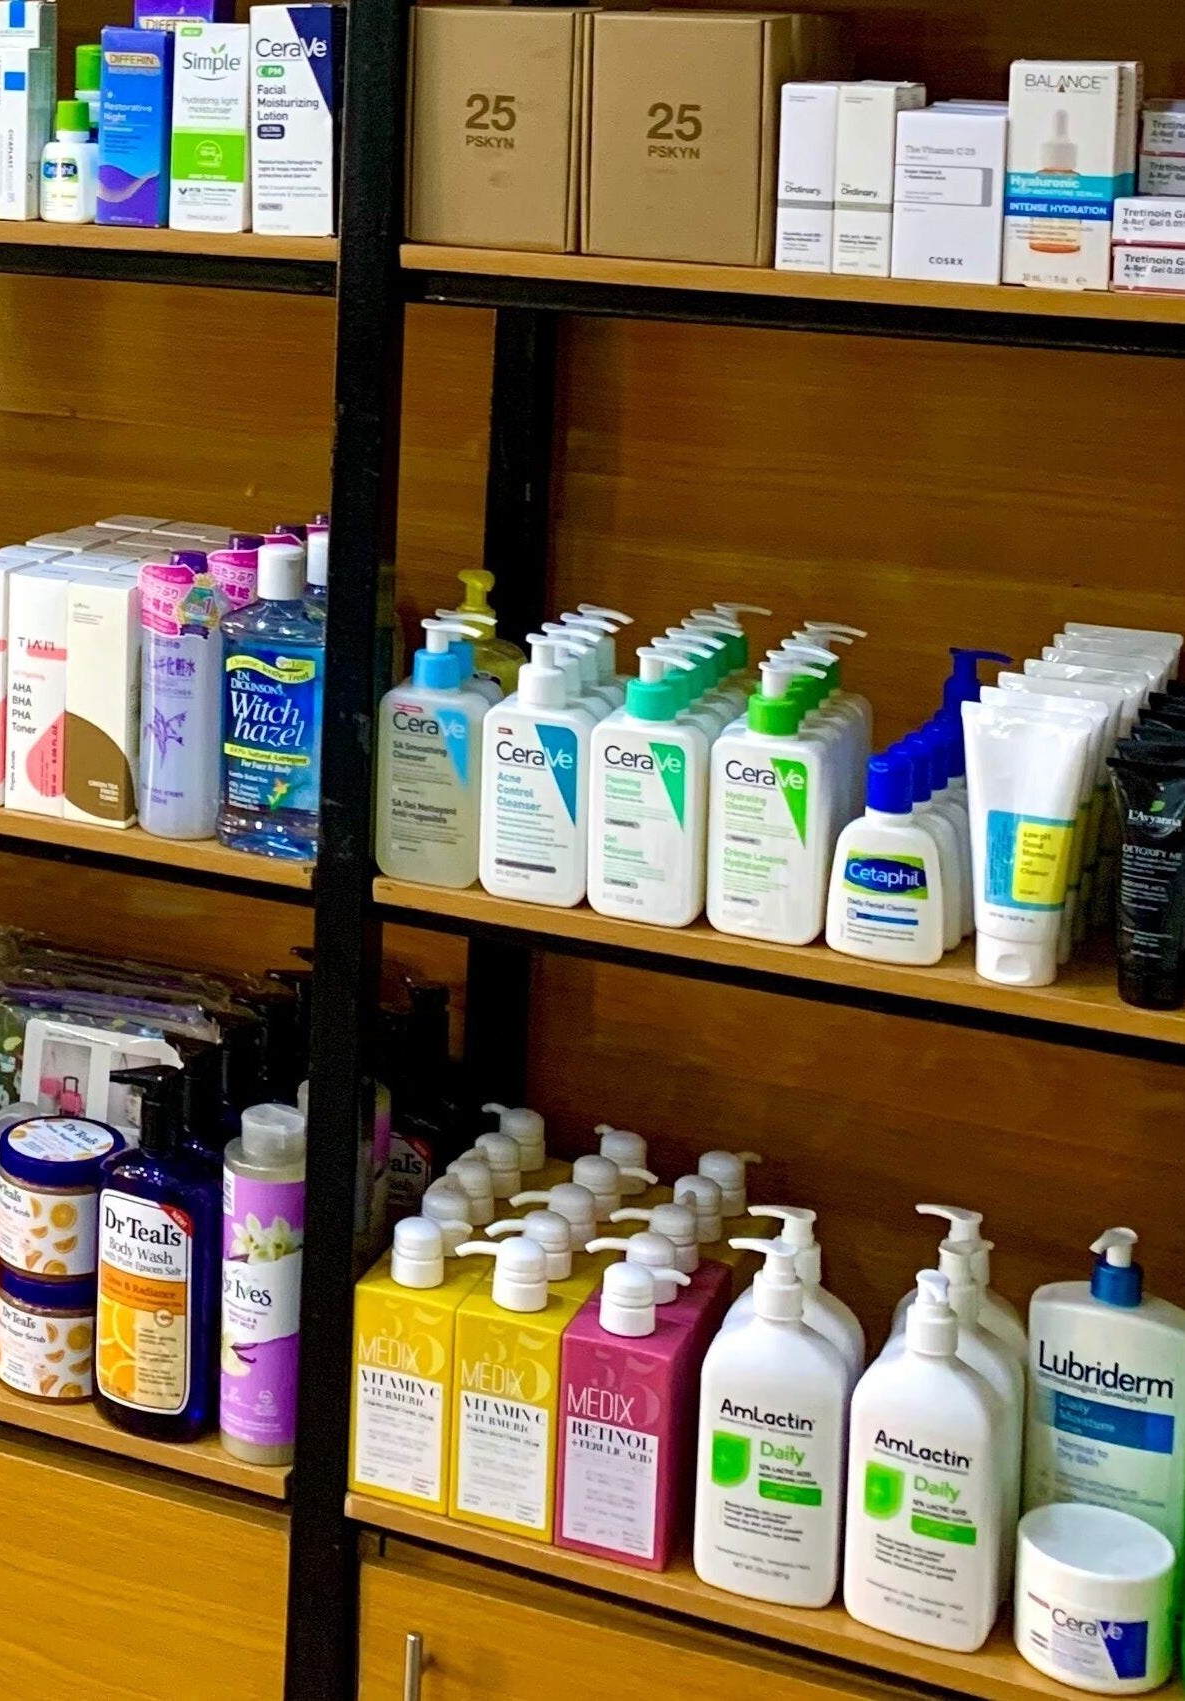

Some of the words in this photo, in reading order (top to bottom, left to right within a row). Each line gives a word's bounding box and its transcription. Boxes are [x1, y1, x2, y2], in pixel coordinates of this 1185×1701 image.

[109, 54, 155, 65] DIFFERIN
[256, 37, 327, 59] CeraVe
[183, 51, 241, 75] Simple
[257, 84, 286, 95] Facial
[1025, 74, 1102, 90] BALANCE
[257, 98, 319, 110] Moisturizing
[257, 111, 288, 121] Lotion
[465, 93, 516, 132] 25
[104, 113, 127, 123] Night
[646, 102, 703, 141] 25
[466, 134, 514, 150] PSKYN
[647, 145, 701, 160] PSKYN
[1011, 176, 1080, 191] Hyaluronic
[1010, 202, 1048, 213] INTENSE
[1050, 204, 1107, 215] HYDRATION
[1123, 208, 1171, 218] Tretinoin
[928, 256, 963, 266] COSRX
[1125, 254, 1173, 265] Tretinoin
[12, 682, 32, 693] AHA
[12, 695, 32, 707] BHA
[230, 690, 300, 726] Witch
[11, 708, 31, 720] PHA
[392, 711, 465, 739] CeraVe
[11, 722, 37, 734] Toner
[234, 712, 305, 747] hazel
[496, 740, 573, 769] CeraVe
[604, 745, 681, 773] CeraVe
[497, 772, 521, 784] Acne
[726, 760, 804, 790] CeraVe
[497, 784, 533, 798] Control
[497, 796, 541, 811] Cleanser
[1122, 843, 1167, 858] DETOXIFY
[849, 863, 920, 888] Cetaphil
[105, 1205, 125, 1234] Dr
[126, 1216, 183, 1247] Teal's
[109, 1236, 133, 1259] Body
[137, 1246, 174, 1265] Wash
[235, 1279, 272, 1307] Ives
[357, 1332, 420, 1375] MEDIX
[461, 1359, 525, 1399] MEDIX
[1039, 1340, 1173, 1399] Lubriderm
[361, 1369, 426, 1396] VITAMIN
[430, 1385, 441, 1400] C
[371, 1386, 424, 1407] TURMERIC
[464, 1395, 531, 1422] VITAMIN
[535, 1413, 546, 1426] C
[567, 1383, 635, 1426] MEDIX
[720, 1398, 814, 1432] AmLactin
[474, 1413, 529, 1434] TURMERIC
[571, 1420, 654, 1453] RETINOL
[760, 1440, 805, 1467] Daily
[874, 1429, 970, 1469] AmLactin
[913, 1475, 960, 1504] Daily
[1052, 1608, 1124, 1640] CeraVe
